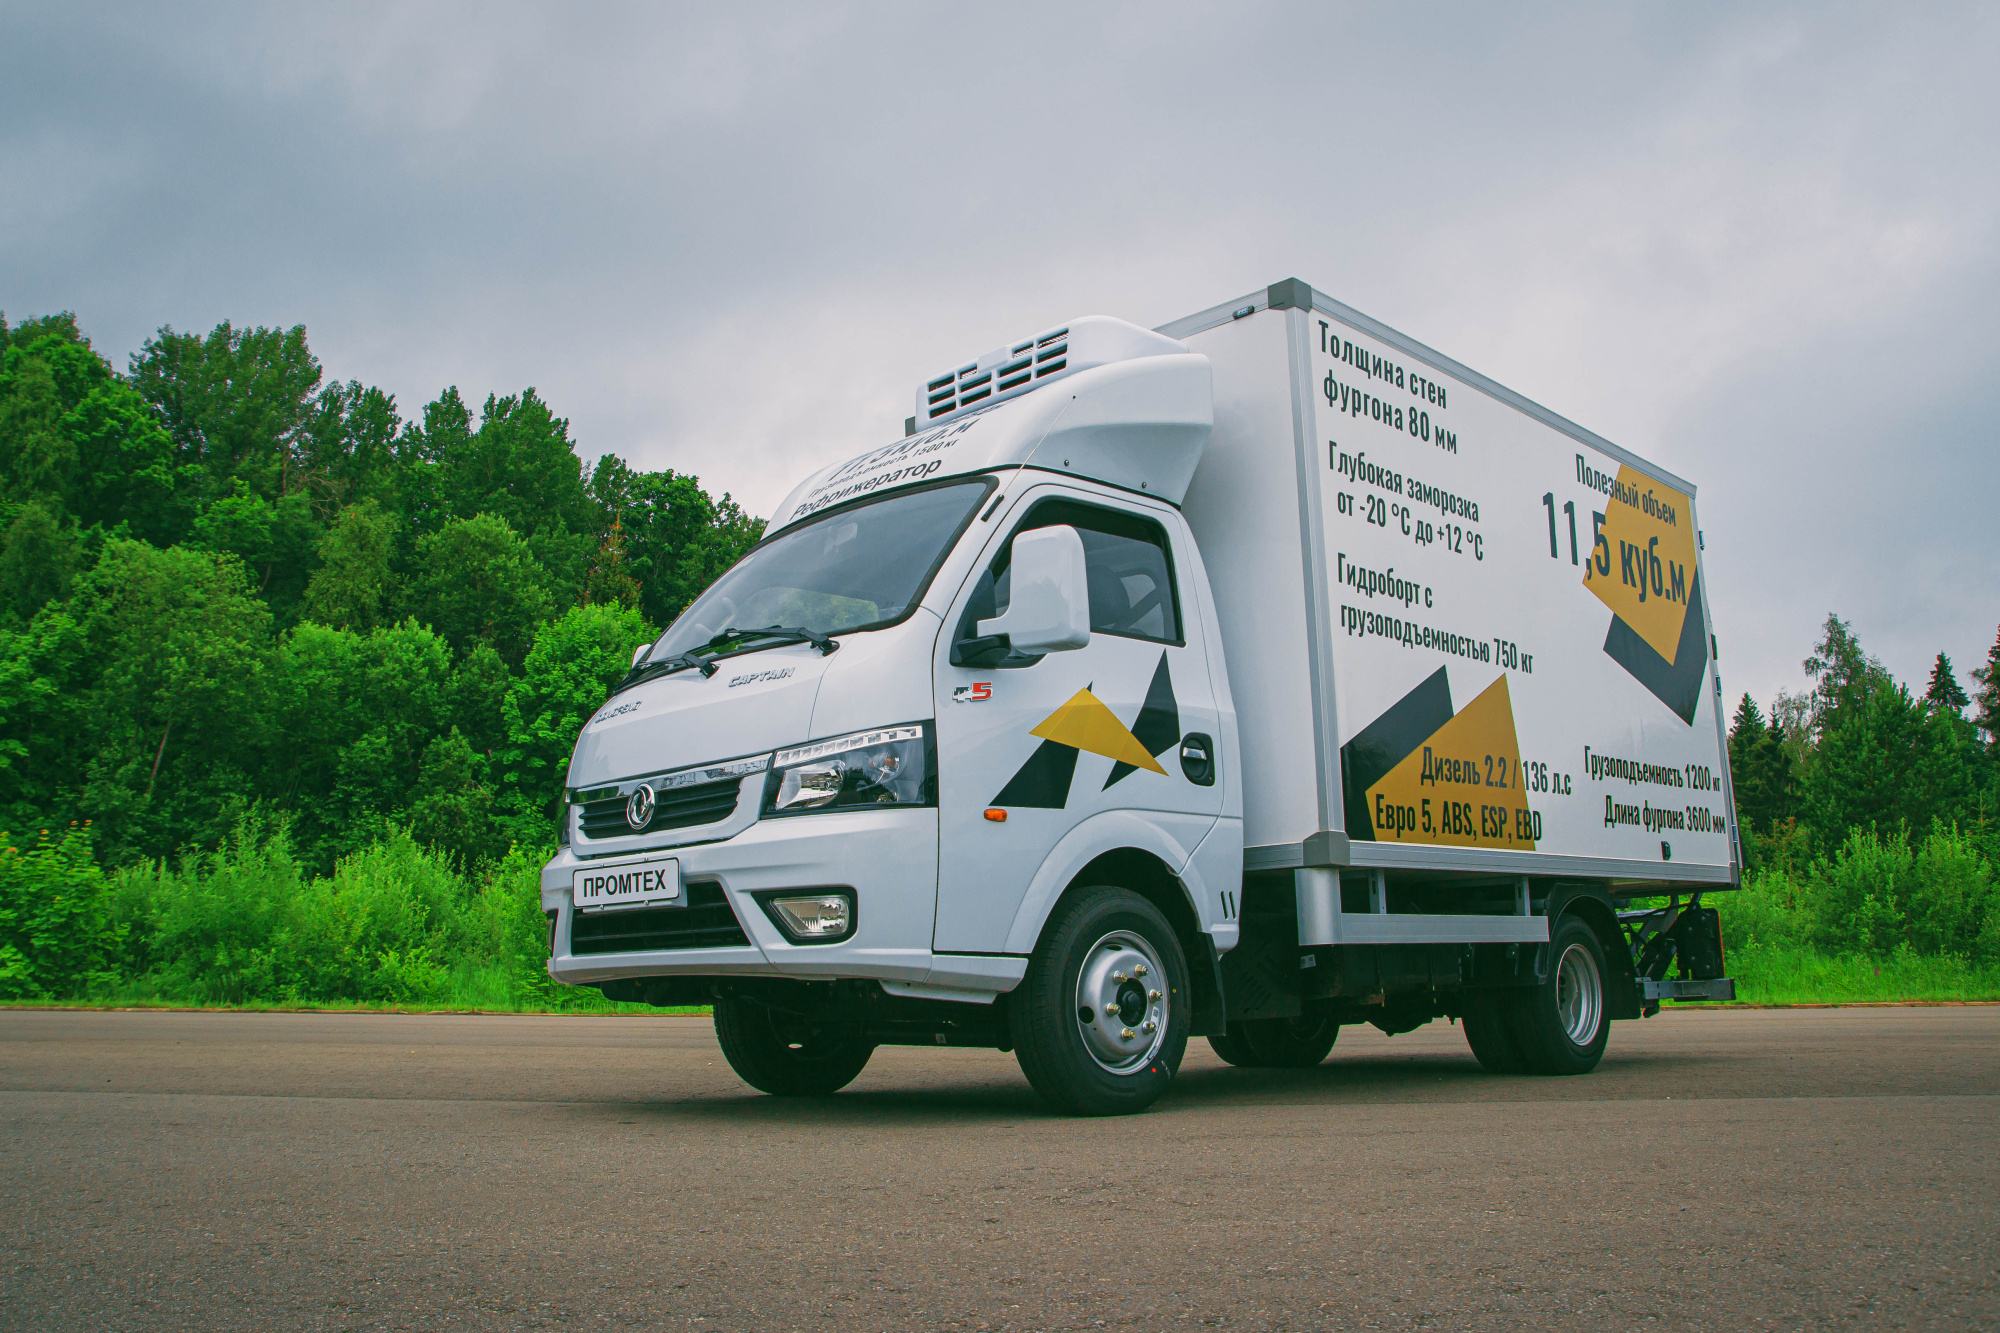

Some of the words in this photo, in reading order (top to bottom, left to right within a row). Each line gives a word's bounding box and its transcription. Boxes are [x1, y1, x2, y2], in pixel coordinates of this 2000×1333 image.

[1318, 319, 1405, 389] Толщина
[1409, 372, 1447, 409] стен
[1323, 369, 1403, 431] фургона
[1408, 406, 1430, 442] 80
[1434, 425, 1457, 455] мм
[912, 441, 945, 457] 1500
[789, 459, 943, 521] Рефрижератор
[1328, 440, 1403, 495] Глубокая
[1406, 477, 1479, 523] заморозка
[1575, 453, 1640, 510] Полезный
[1642, 489, 1677, 527] объем
[1337, 491, 1354, 517] от
[1359, 494, 1386, 528] -20
[1415, 519, 1433, 547] до
[1437, 523, 1463, 555] +12
[1542, 491, 1611, 581] 11,5
[1619, 535, 1687, 606] куб.м
[1337, 552, 1421, 608] Гидроборт
[1424, 586, 1433, 608] с
[1340, 604, 1490, 663] грузоподъемностью
[1493, 637, 1518, 671] 750
[1520, 652, 1534, 674] кг
[728, 667, 796, 688] CAPTAIN
[1420, 746, 1481, 787] Дизель
[1484, 754, 1508, 789] 2.2
[1522, 760, 1548, 793] 136
[1584, 745, 1684, 788] Грузоподъемность
[1684, 763, 1711, 791] 1200
[1712, 776, 1721, 792] кг
[1375, 793, 1416, 838] Евро
[1421, 798, 1437, 839] 5,
[1441, 800, 1477, 841] ABS,
[1515, 808, 1542, 841] EBD
[1604, 794, 1641, 829] Длина
[1642, 799, 1685, 834] фургона
[1685, 805, 1711, 832] 3600
[1712, 815, 1727, 834] мм
[583, 868, 667, 898] ПРОМТЕХ
